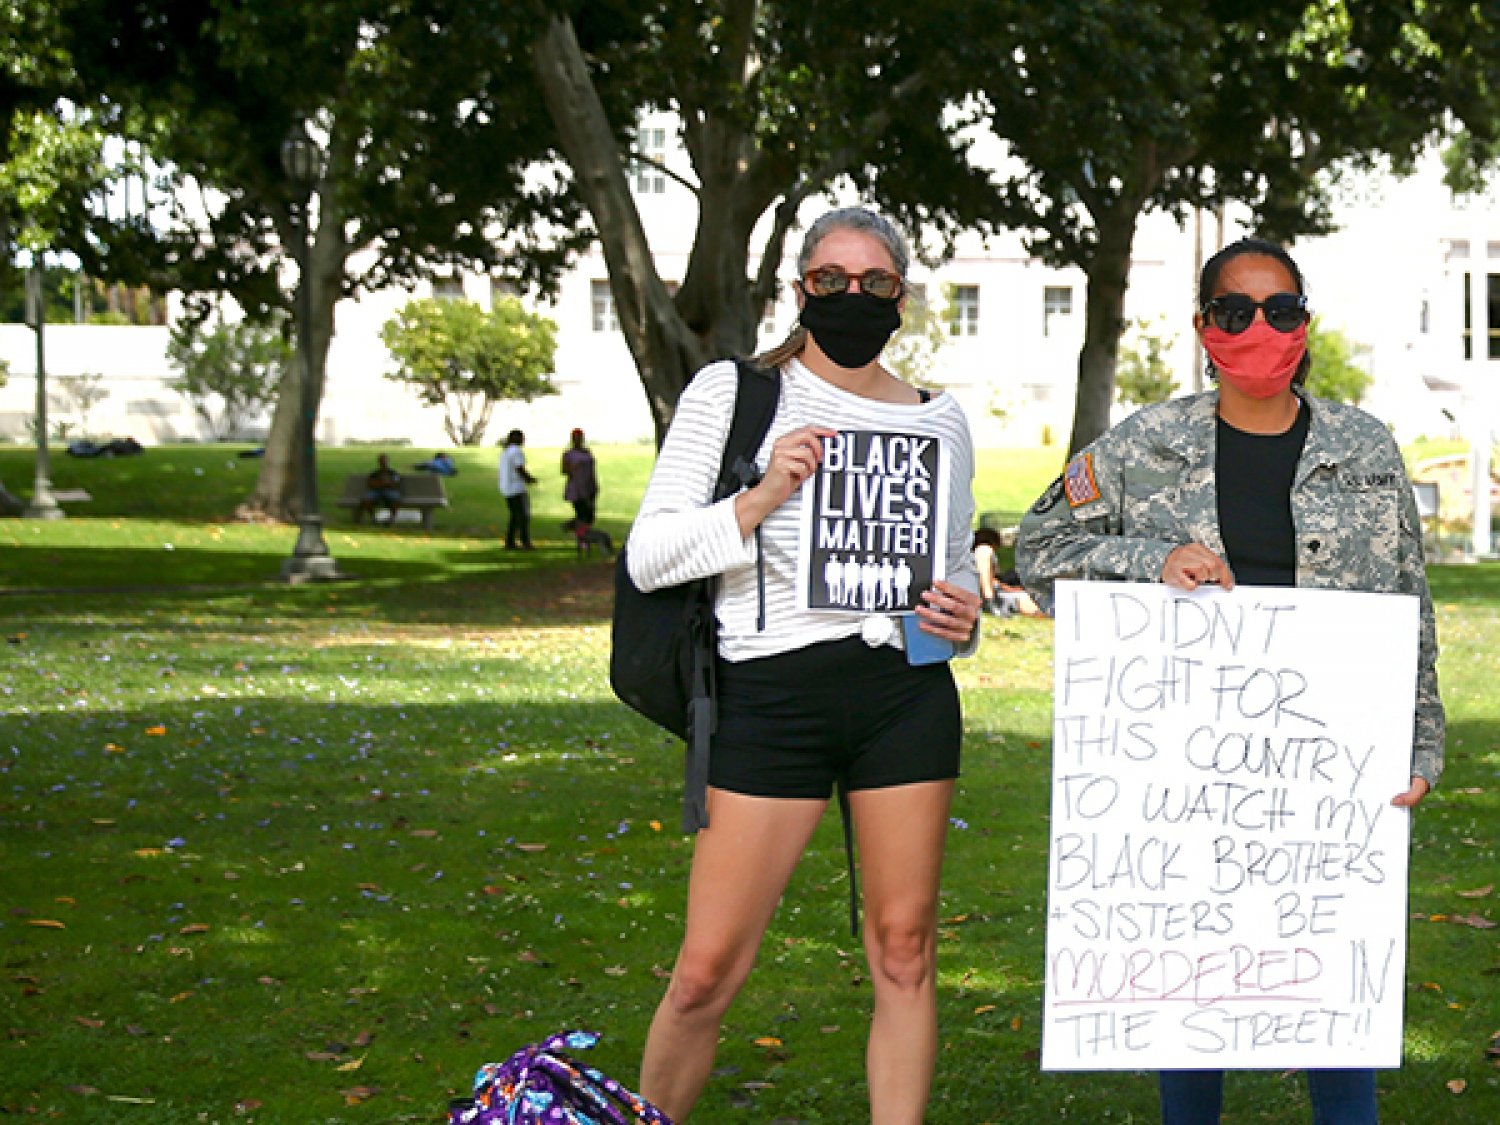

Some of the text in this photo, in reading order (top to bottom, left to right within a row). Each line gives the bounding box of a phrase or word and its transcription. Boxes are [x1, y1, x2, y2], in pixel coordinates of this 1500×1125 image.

[823, 433, 930, 478] BLACK
[820, 472, 930, 523] LIVES
[819, 518, 928, 554] MATTER
[1073, 591, 1297, 655] I DIDN'T
[1064, 656, 1328, 728] FIGHT FOR
[1055, 716, 1375, 796] THIS COUNTRY
[1057, 773, 1119, 820] TO
[1143, 783, 1296, 832] WATCH
[1055, 832, 1386, 895] BLACK BROTHERS
[1275, 892, 1346, 938] BE
[1052, 938, 1396, 1007] MURDERED IN
[1054, 1010, 1159, 1057] THE
